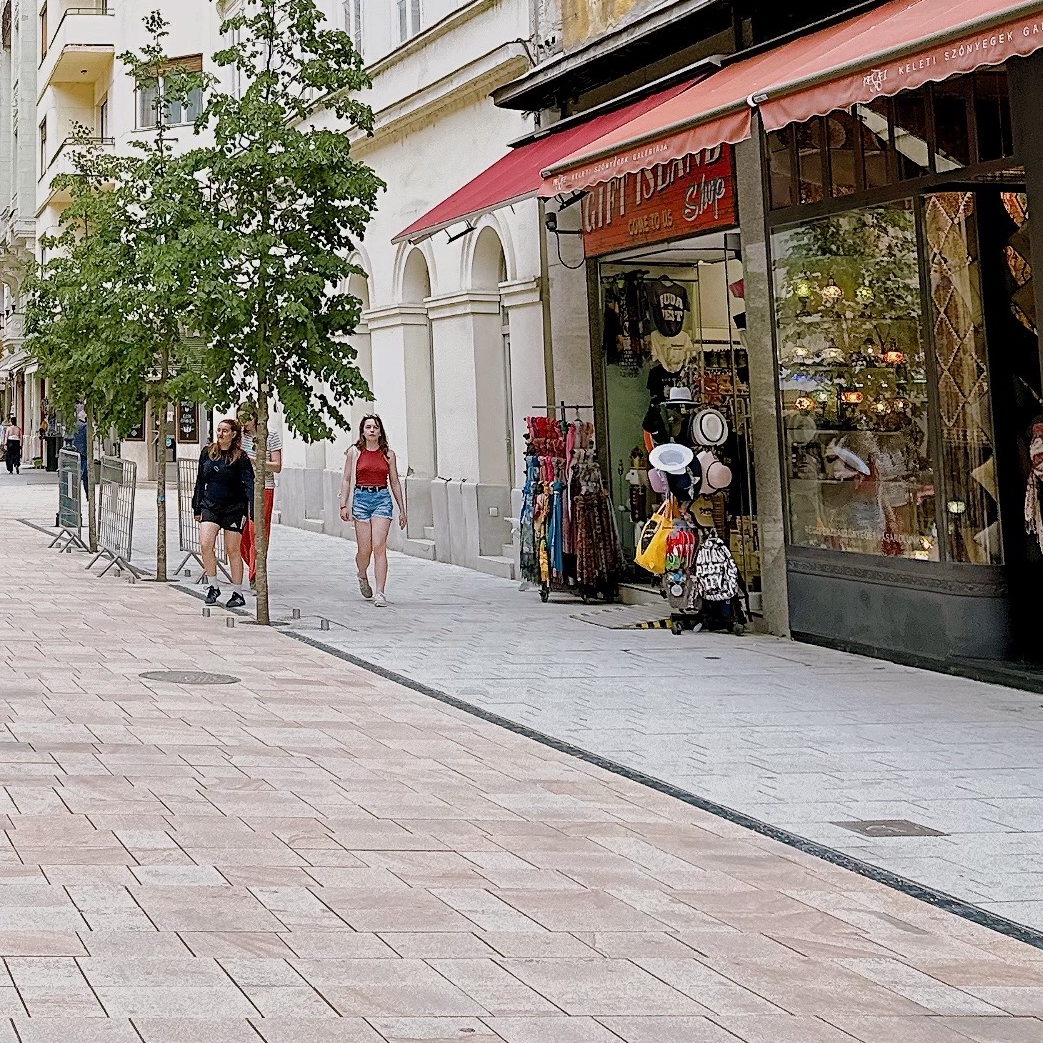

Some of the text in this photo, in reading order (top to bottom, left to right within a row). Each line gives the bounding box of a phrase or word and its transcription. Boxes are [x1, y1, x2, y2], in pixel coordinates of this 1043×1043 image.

[898, 56, 936, 75] KELETI
[1022, 21, 1043, 37] GA
[585, 177, 628, 233] GIFT
